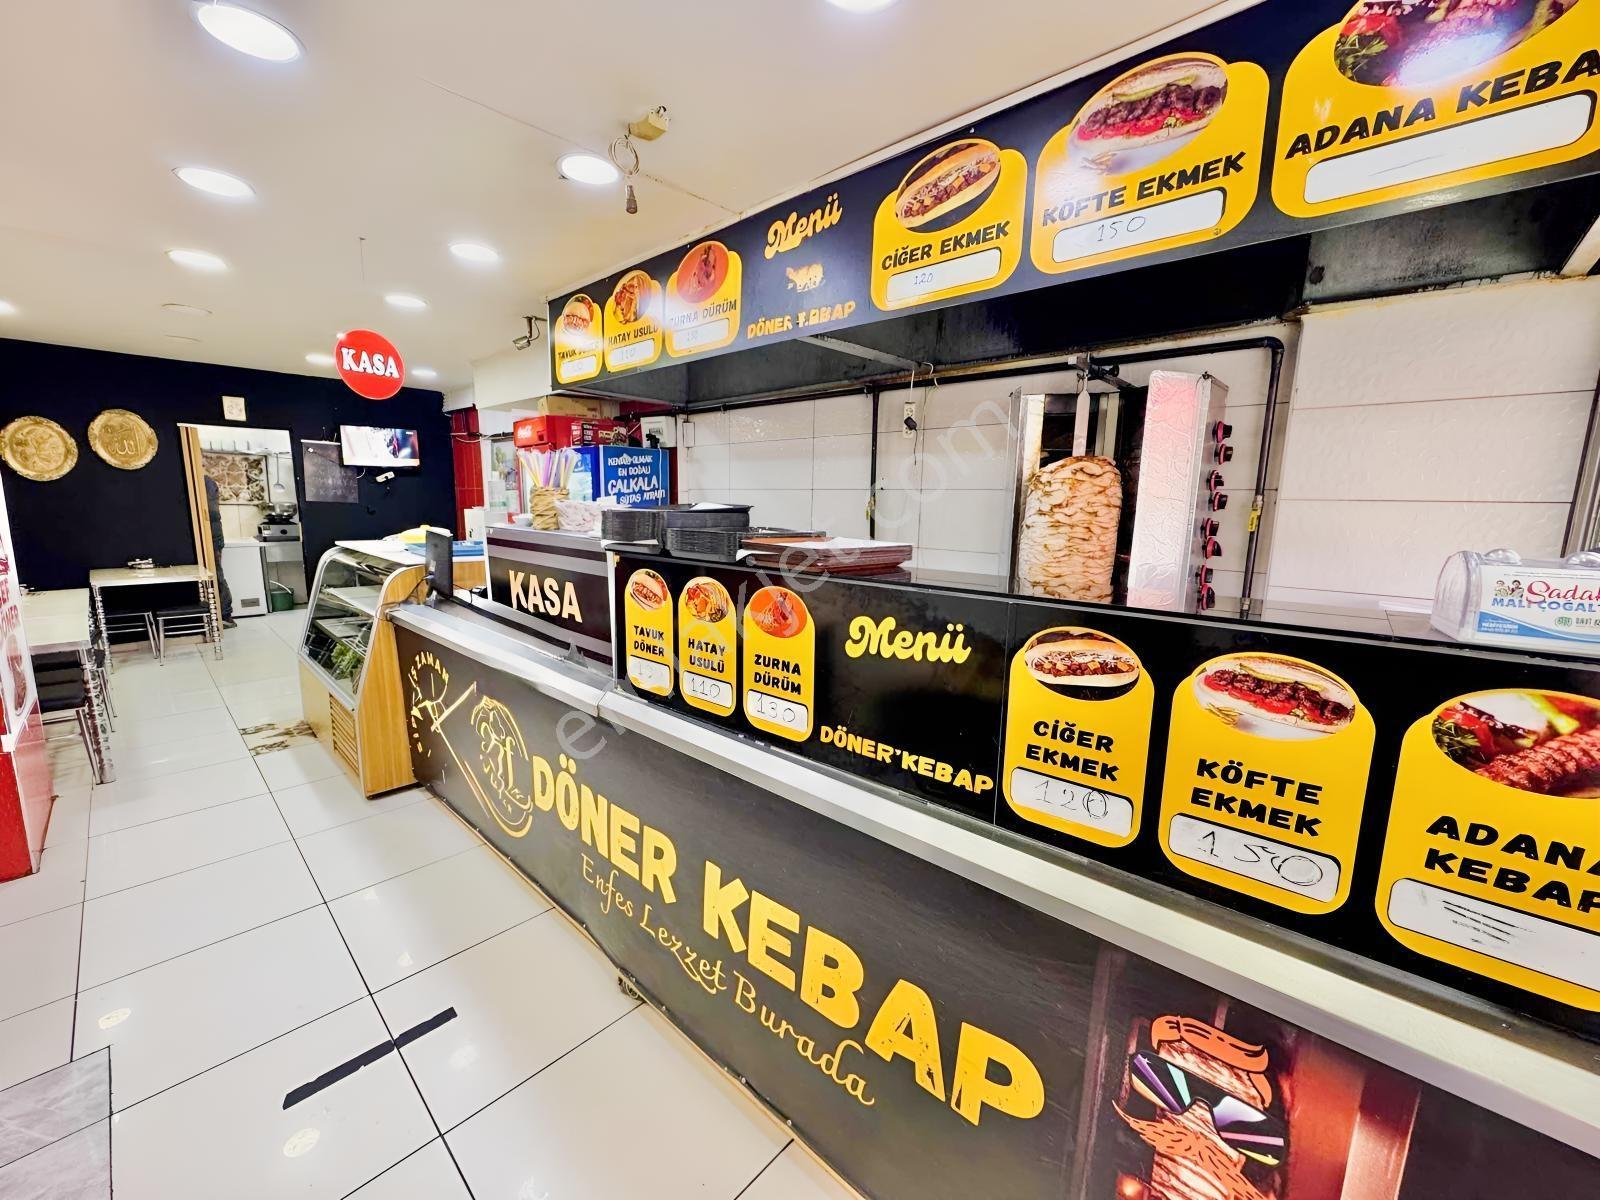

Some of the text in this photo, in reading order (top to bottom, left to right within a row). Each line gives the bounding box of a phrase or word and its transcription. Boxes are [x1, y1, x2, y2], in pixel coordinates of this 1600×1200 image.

[1284, 97, 1436, 160] ADANA
[1042, 151, 1247, 227] KÖFTE EKMEK
[764, 191, 843, 260] Menü
[1096, 215, 1147, 243] 150
[881, 219, 1011, 271] CİĞER EKMEK
[912, 271, 934, 287] 120
[701, 298, 738, 319] DÜRÜM
[607, 331, 631, 346] HATAY
[746, 314, 794, 340] DÖNER
[340, 347, 400, 379] KASA
[607, 475, 659, 496] ÇALKALA
[508, 569, 583, 624] KASA
[1525, 580, 1600, 604] Sada
[1533, 599, 1600, 613] ÇOĞAL
[633, 624, 665, 642] TAVUK
[633, 638, 665, 657] DÖNER
[687, 637, 727, 656] HATAY
[845, 615, 972, 665] Menü
[689, 653, 726, 674] USULÜ
[753, 653, 802, 677] ZURNA
[690, 676, 721, 700] 110
[753, 670, 802, 696] DÜRÜM
[756, 694, 796, 724] 130
[1033, 719, 1115, 755] CİĞER
[1025, 743, 1120, 782] EKMEK
[1196, 758, 1323, 806] KÖFTE
[1034, 779, 1110, 820] 120
[1190, 786, 1323, 838] EKMEK
[1197, 829, 1324, 887] 150
[1426, 815, 1600, 876] ADAN
[532, 754, 1045, 1126] DÖNER KEBAP
[580, 852, 876, 1106] Enfes Lezzet Burada
